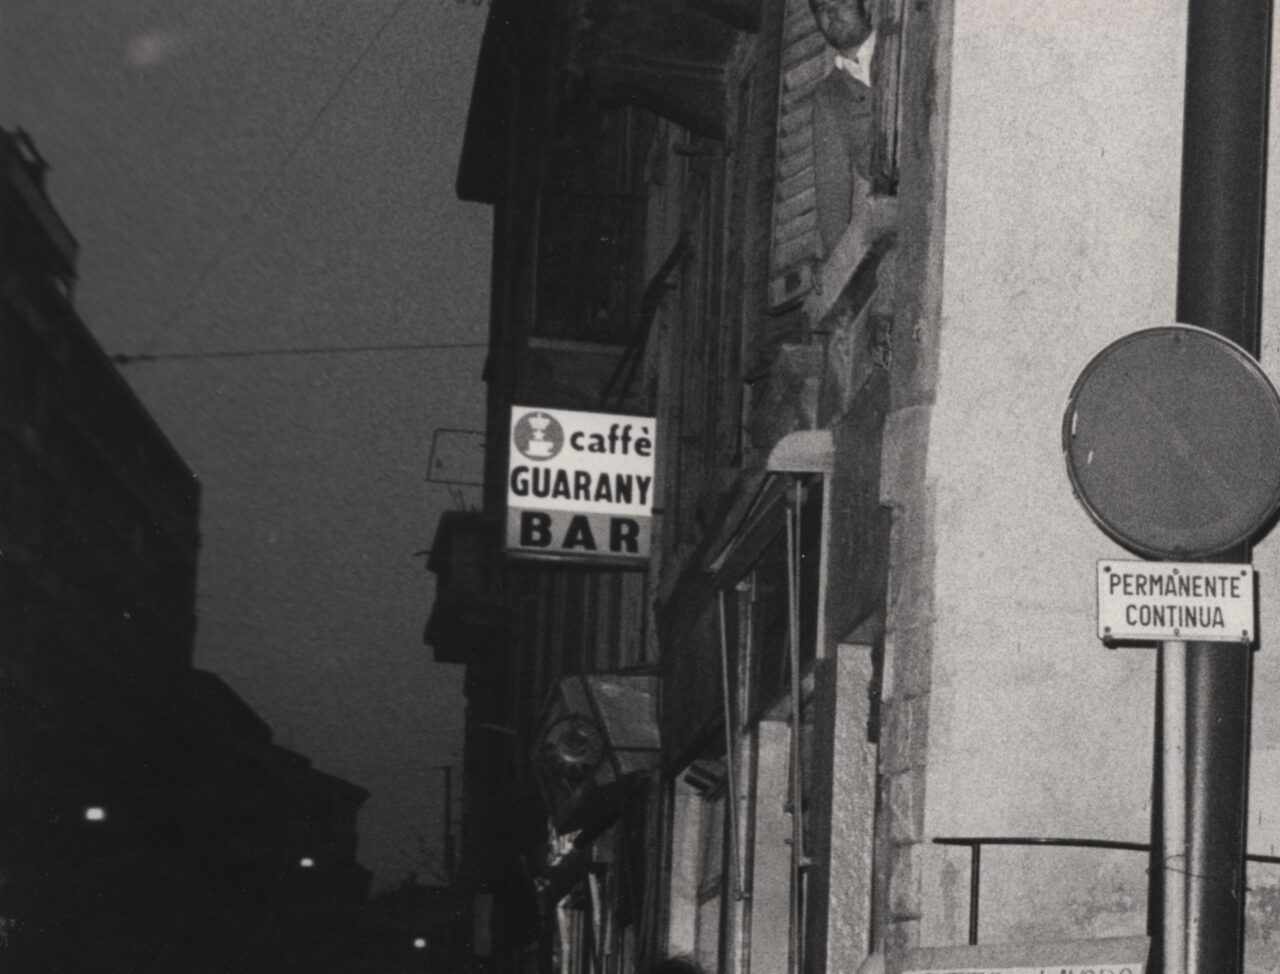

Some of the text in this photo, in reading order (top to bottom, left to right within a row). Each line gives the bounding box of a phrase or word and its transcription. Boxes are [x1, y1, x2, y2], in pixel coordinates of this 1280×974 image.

[570, 423, 652, 456] caffè
[510, 465, 651, 505] GUARANY
[520, 511, 640, 553] BAR
[1109, 573, 1241, 598] PERMANENTE
[1125, 604, 1225, 628] CONTINUA
